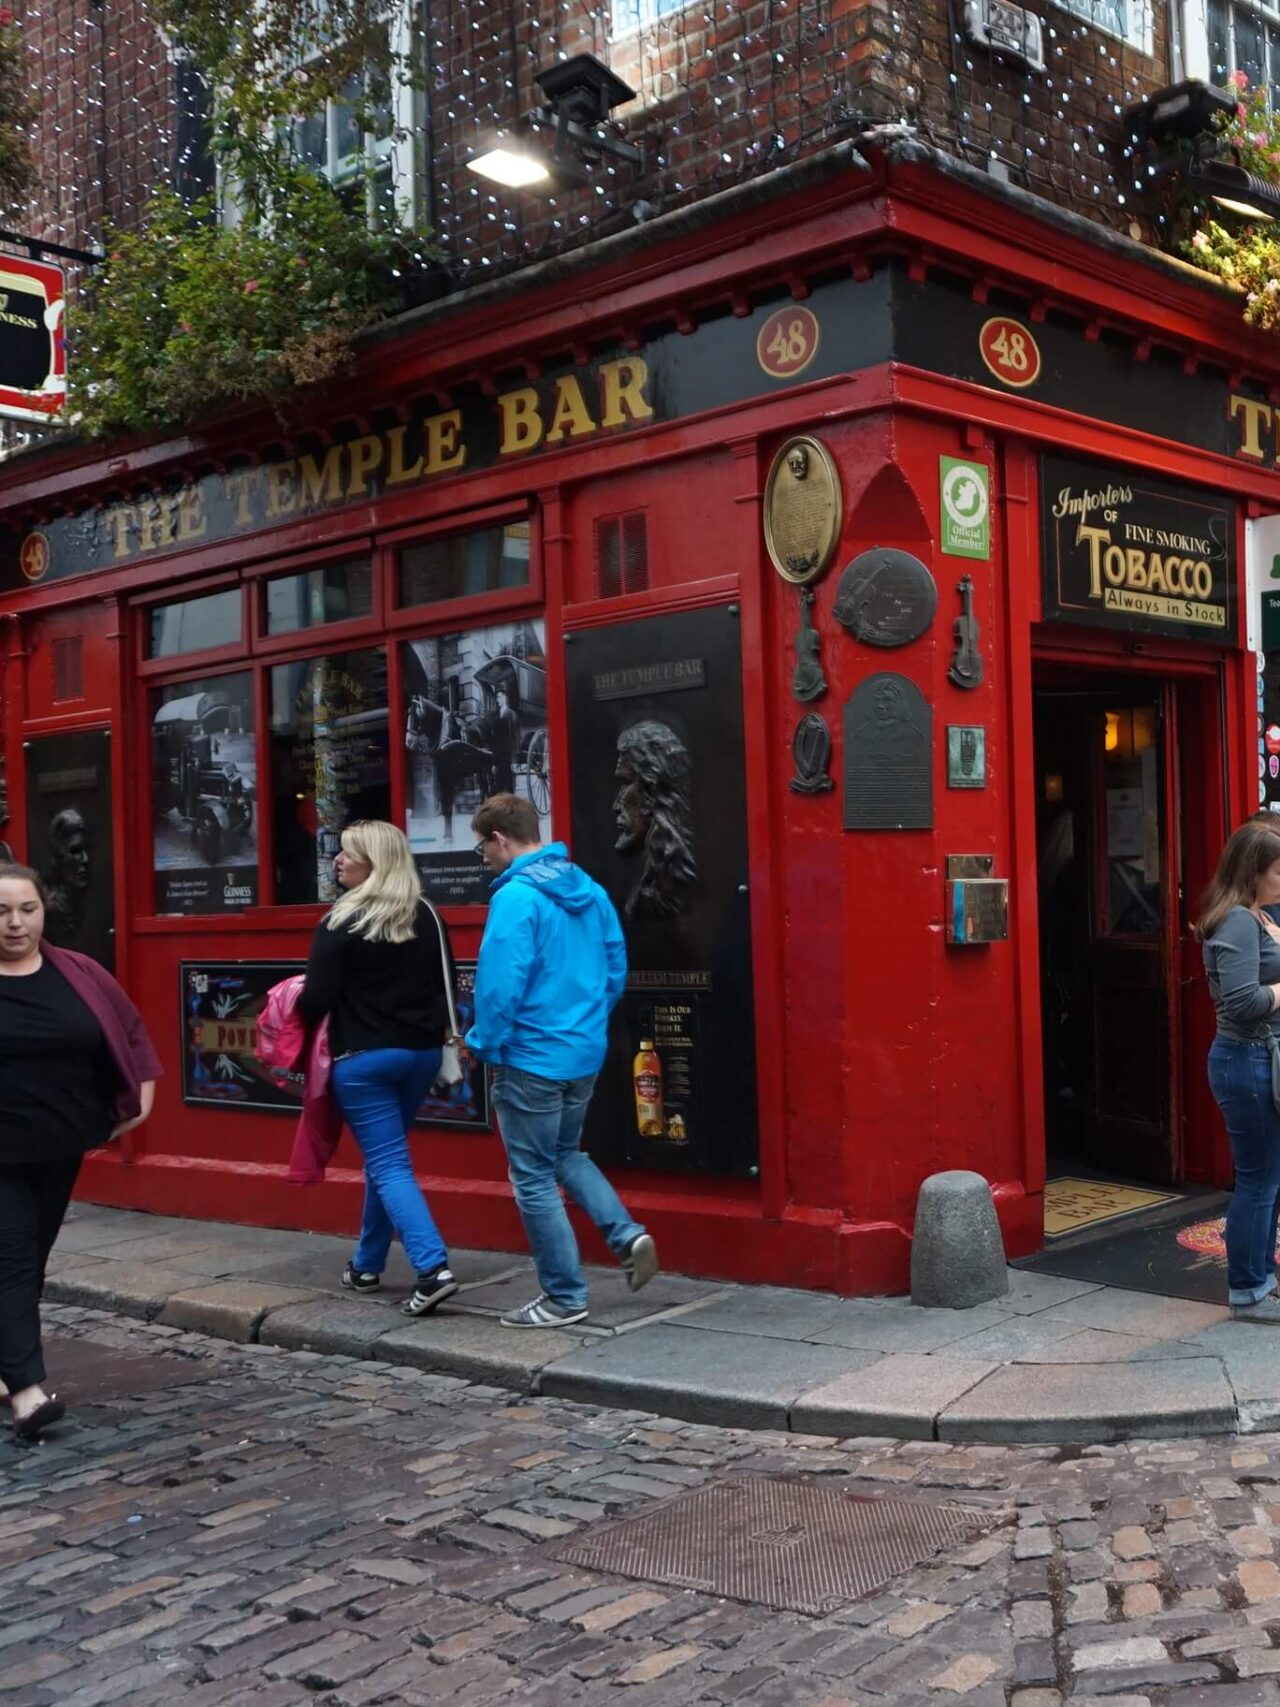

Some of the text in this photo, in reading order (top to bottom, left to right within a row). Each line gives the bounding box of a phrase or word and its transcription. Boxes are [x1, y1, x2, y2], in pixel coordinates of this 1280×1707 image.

[767, 319, 807, 365] 48
[990, 327, 1028, 370] 48
[225, 409, 466, 526] TEMPLE
[498, 356, 653, 455] BAR
[1052, 484, 1133, 524] Importers
[1104, 509, 1118, 523] OF
[1125, 523, 1211, 555] FINE SMOKING
[1076, 524, 1213, 600] TOBACCO
[1107, 589, 1223, 623] Always in Stock
